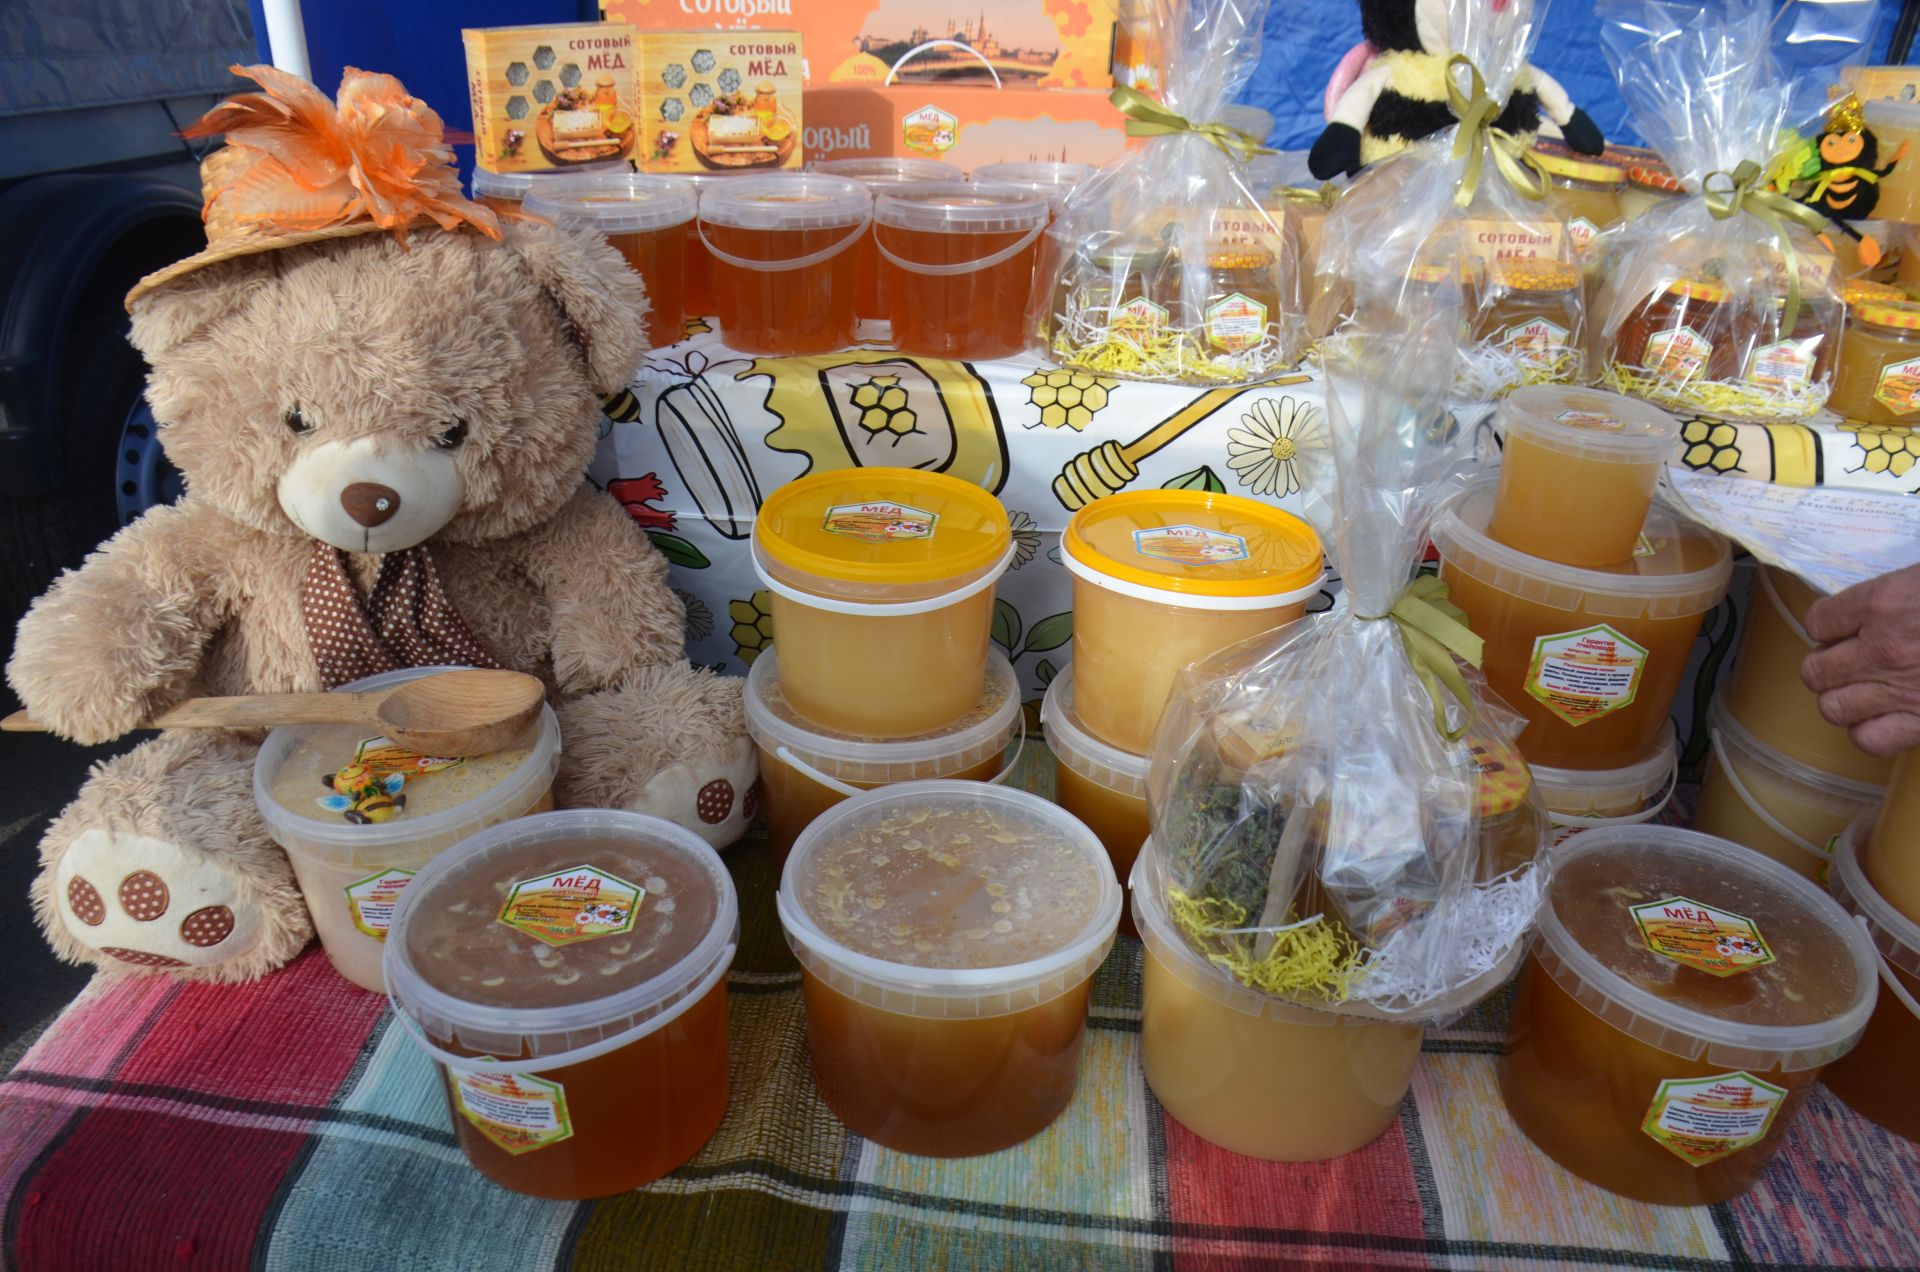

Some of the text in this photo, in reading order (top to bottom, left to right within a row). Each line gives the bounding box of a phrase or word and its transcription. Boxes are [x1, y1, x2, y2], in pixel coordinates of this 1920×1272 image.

[569, 36, 632, 50] СОТОВЫЙ
[729, 42, 796, 56] СОТОВЫЙ
[587, 50, 626, 70] МЁД
[747, 57, 788, 77] МЁД
[852, 64, 877, 76] 100%
[919, 112, 940, 122] МЁД
[1478, 232, 1553, 246] СОТОВЫЙ
[1524, 325, 1550, 336] МЁД
[860, 504, 903, 517] МЁД
[552, 875, 602, 892] МЁД
[1663, 906, 1715, 924] МЁД
